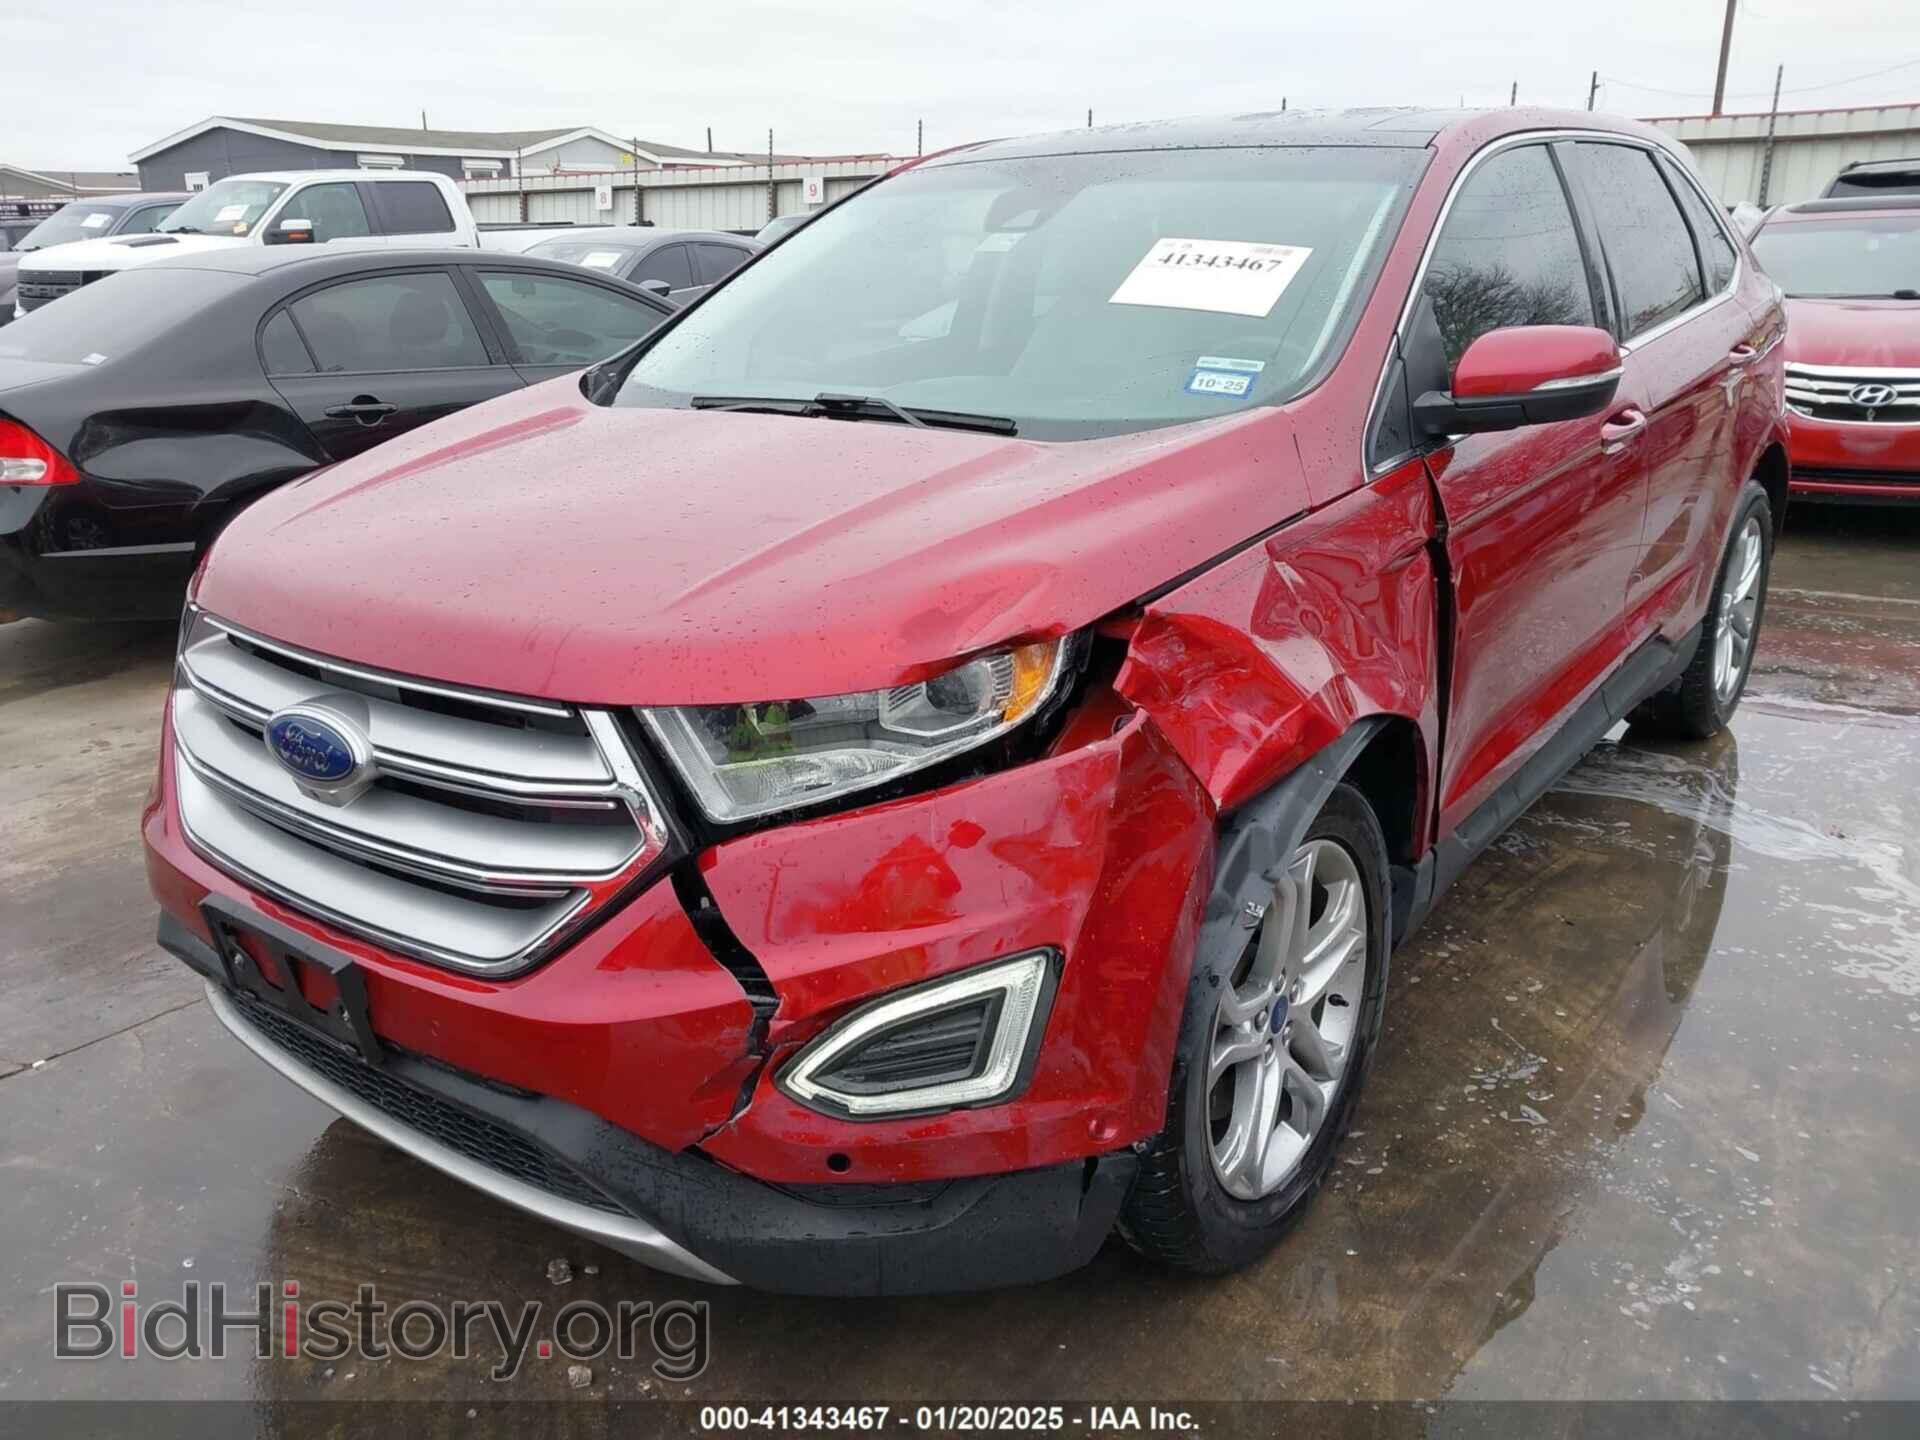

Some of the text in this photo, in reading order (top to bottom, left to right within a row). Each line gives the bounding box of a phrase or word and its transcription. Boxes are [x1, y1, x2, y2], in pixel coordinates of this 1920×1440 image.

[809, 183, 817, 197] 9
[600, 191, 608, 204] 8
[1158, 252, 1283, 272] 41343467
